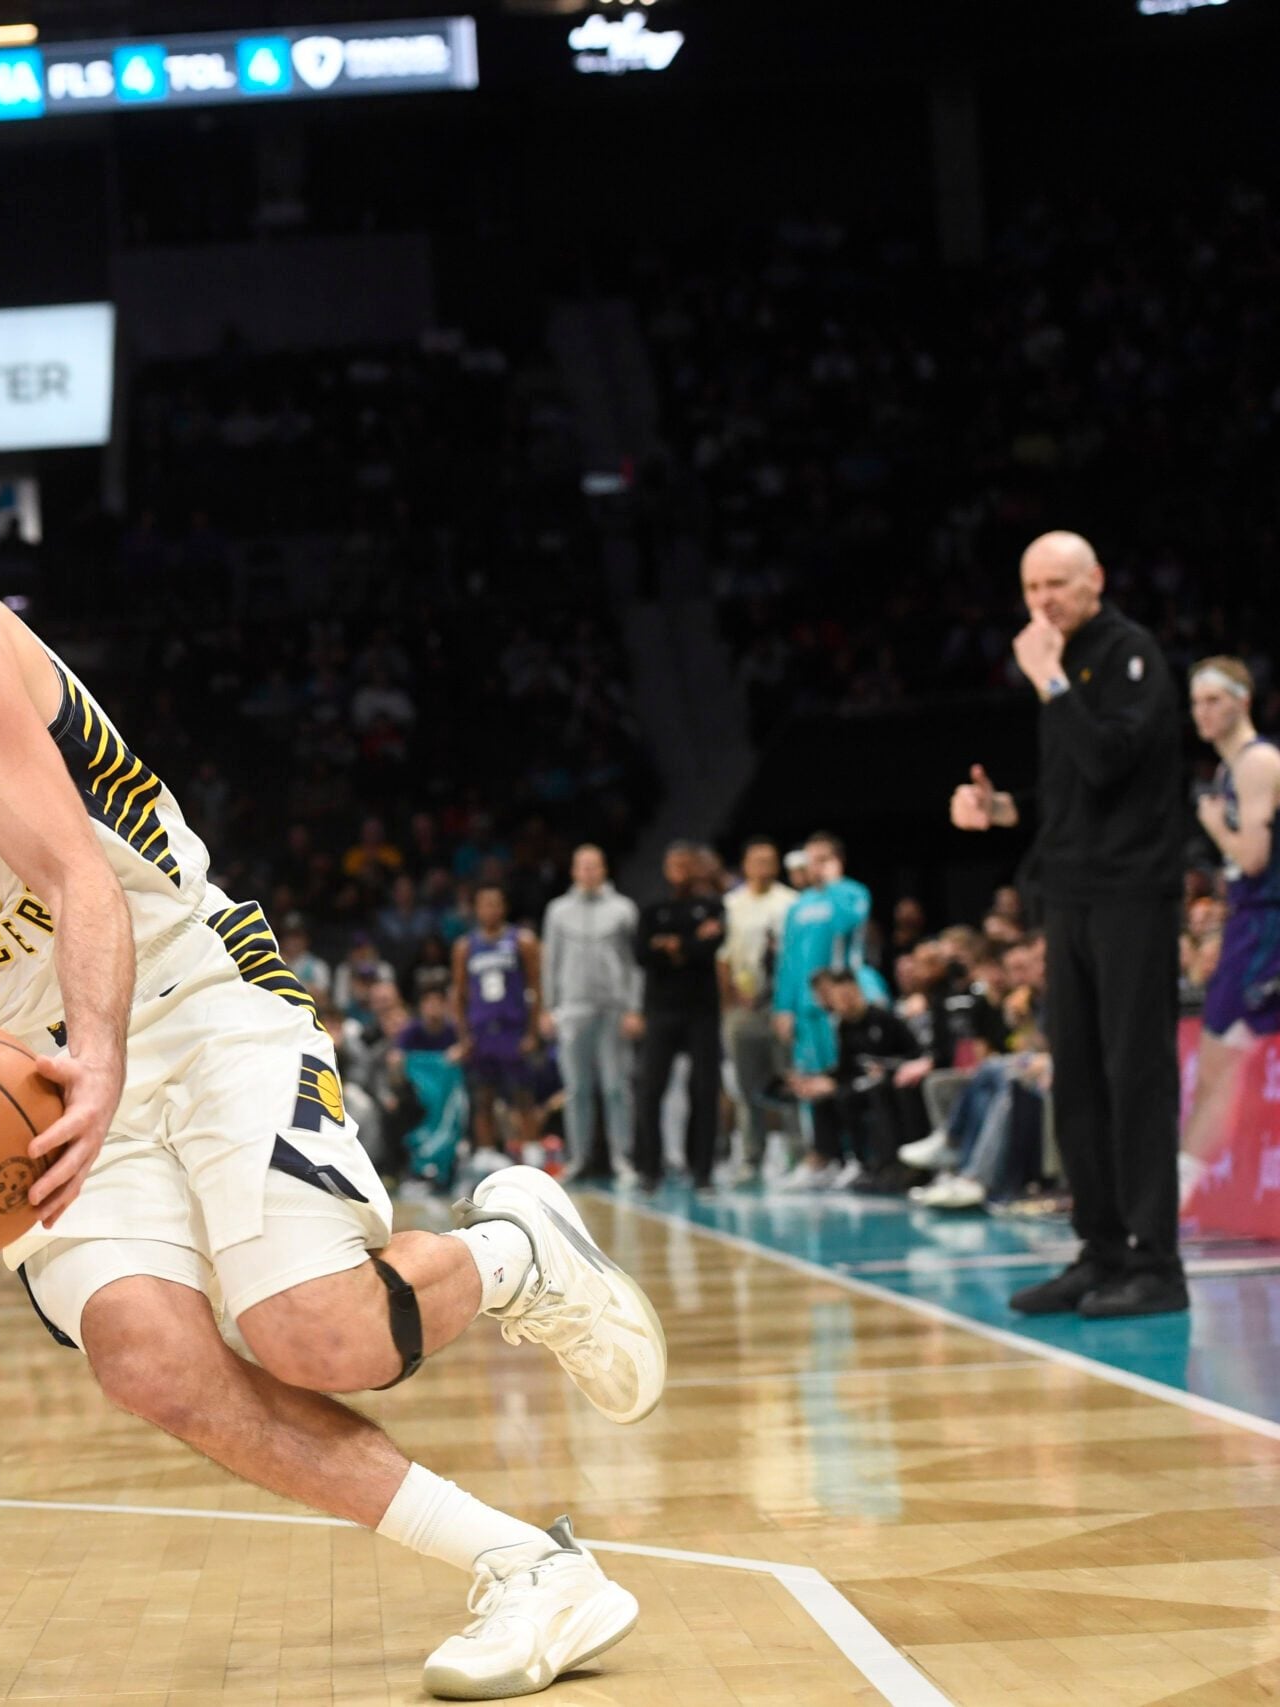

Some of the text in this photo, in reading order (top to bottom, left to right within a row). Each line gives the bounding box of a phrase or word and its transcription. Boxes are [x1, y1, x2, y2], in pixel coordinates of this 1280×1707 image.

[48, 60, 114, 99] FLS
[122, 54, 155, 93] 4
[247, 46, 281, 85] 4
